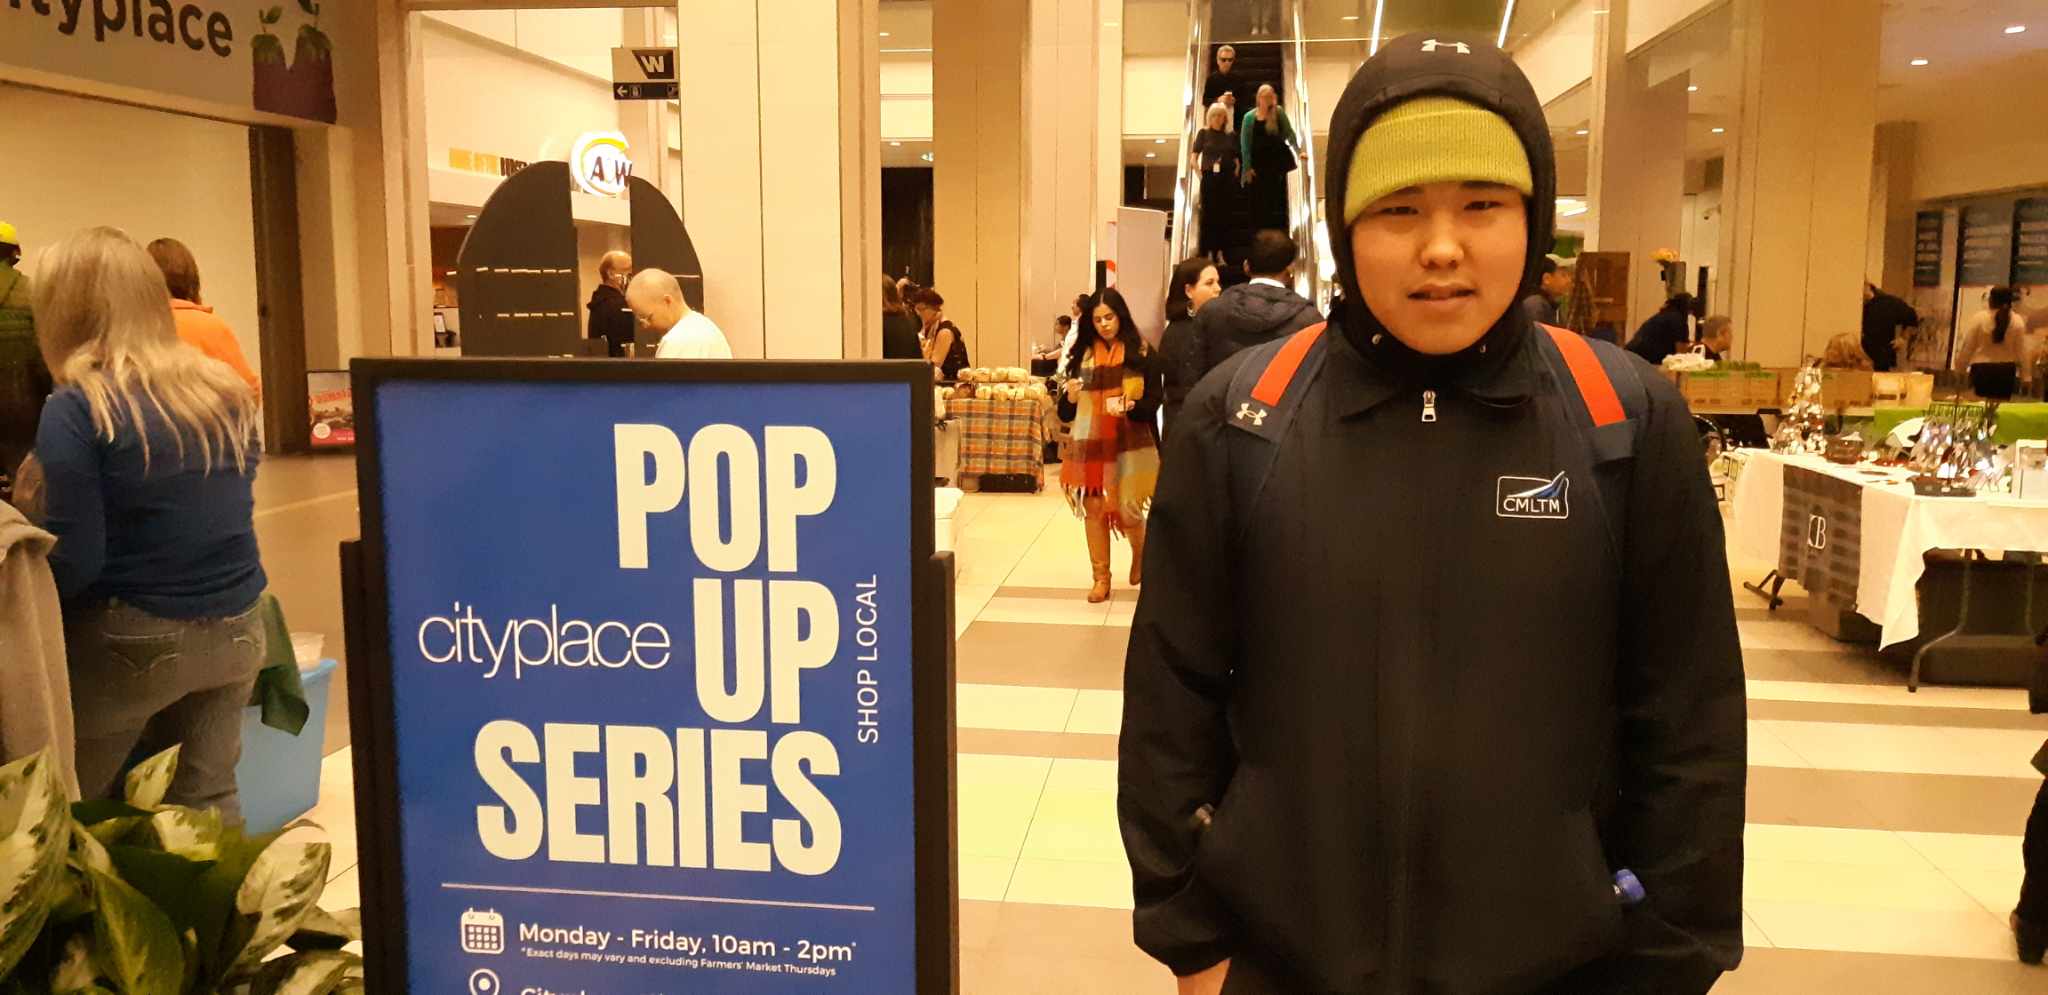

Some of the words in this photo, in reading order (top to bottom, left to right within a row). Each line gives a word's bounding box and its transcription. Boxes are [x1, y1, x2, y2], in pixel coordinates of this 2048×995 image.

[10, 0, 233, 57] yplace
[613, 423, 838, 573] POP
[1503, 498, 1560, 513] CMLTM
[418, 601, 671, 679] cityplace
[692, 577, 840, 724] UP
[856, 574, 878, 661] LOCAL
[856, 669, 879, 744] SHOP
[473, 719, 843, 876] SERIES
[519, 922, 611, 950] Monday
[631, 929, 706, 956] Friday,
[711, 934, 776, 957] 10am
[556, 950, 578, 961] days
[581, 952, 602, 963] may
[604, 954, 625, 965] vary
[627, 953, 647, 964] and
[649, 956, 698, 969] excluding
[746, 961, 782, 973] Market
[784, 963, 836, 977] Thursdays
